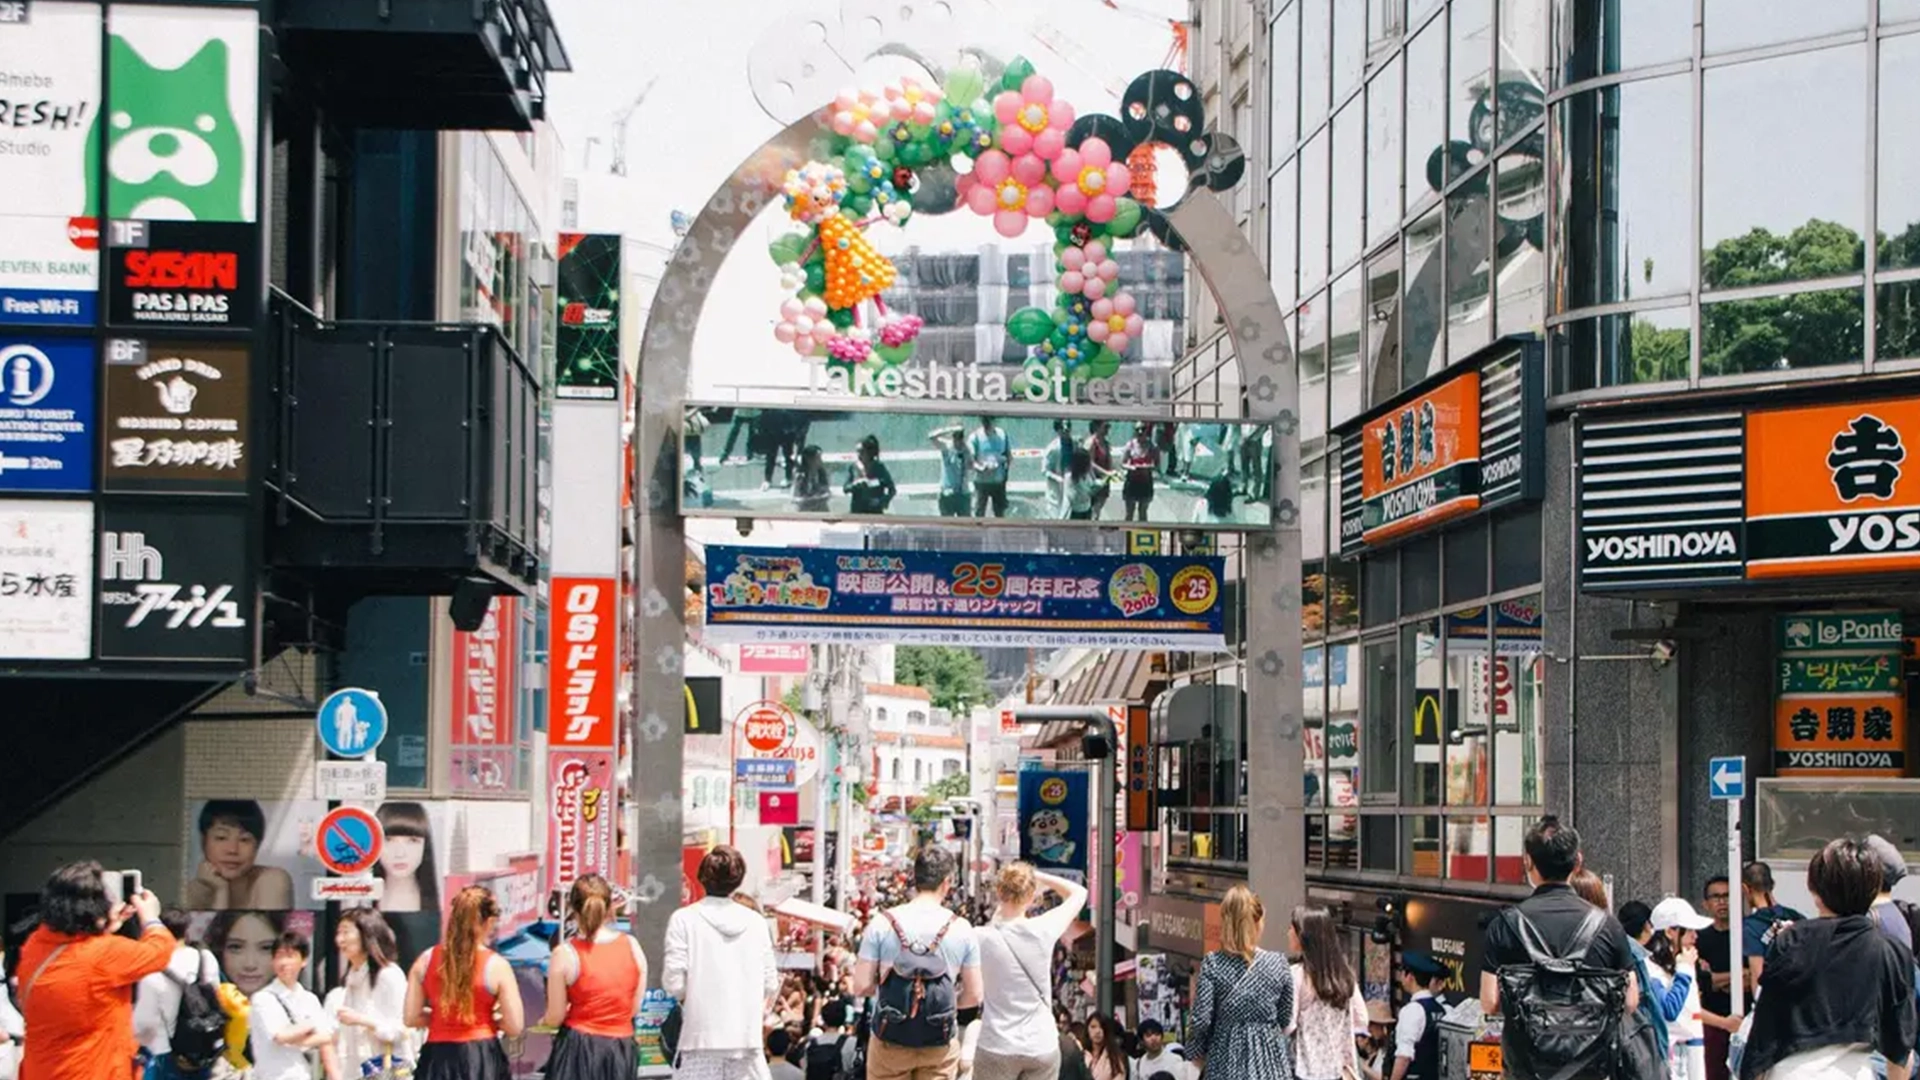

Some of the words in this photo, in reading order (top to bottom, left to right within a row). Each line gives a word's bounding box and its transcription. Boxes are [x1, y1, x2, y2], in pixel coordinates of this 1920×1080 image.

[0, 140, 51, 156] Studio
[113, 221, 143, 244] 1F
[47, 261, 90, 275] BANK
[3, 296, 39, 314] Free
[38, 298, 79, 315] Wi-Fi
[132, 292, 173, 311] PAS
[189, 293, 229, 312] PAS
[109, 339, 140, 361] BF
[805, 360, 1007, 402] Takeshita
[110, 436, 243, 470] 星乃珈琲
[1826, 414, 1906, 503] 吉
[1482, 454, 1521, 484] YOSHINOYA
[1382, 477, 1437, 521] YOSHINOYA
[1587, 530, 1736, 561] YOSHINOYA
[1188, 578, 1208, 599] 25
[1123, 594, 1156, 614] 2016
[565, 584, 600, 741] OSドラッグ
[1806, 657, 1889, 677] ビリヤード
[1819, 675, 1876, 690] ダーツ
[1789, 707, 1893, 741] 吉野家
[1789, 752, 1892, 768] YOSHINOYA
[600, 790, 609, 877] ENTERTAINMEN
[1431, 937, 1465, 956] WOLFGANG
